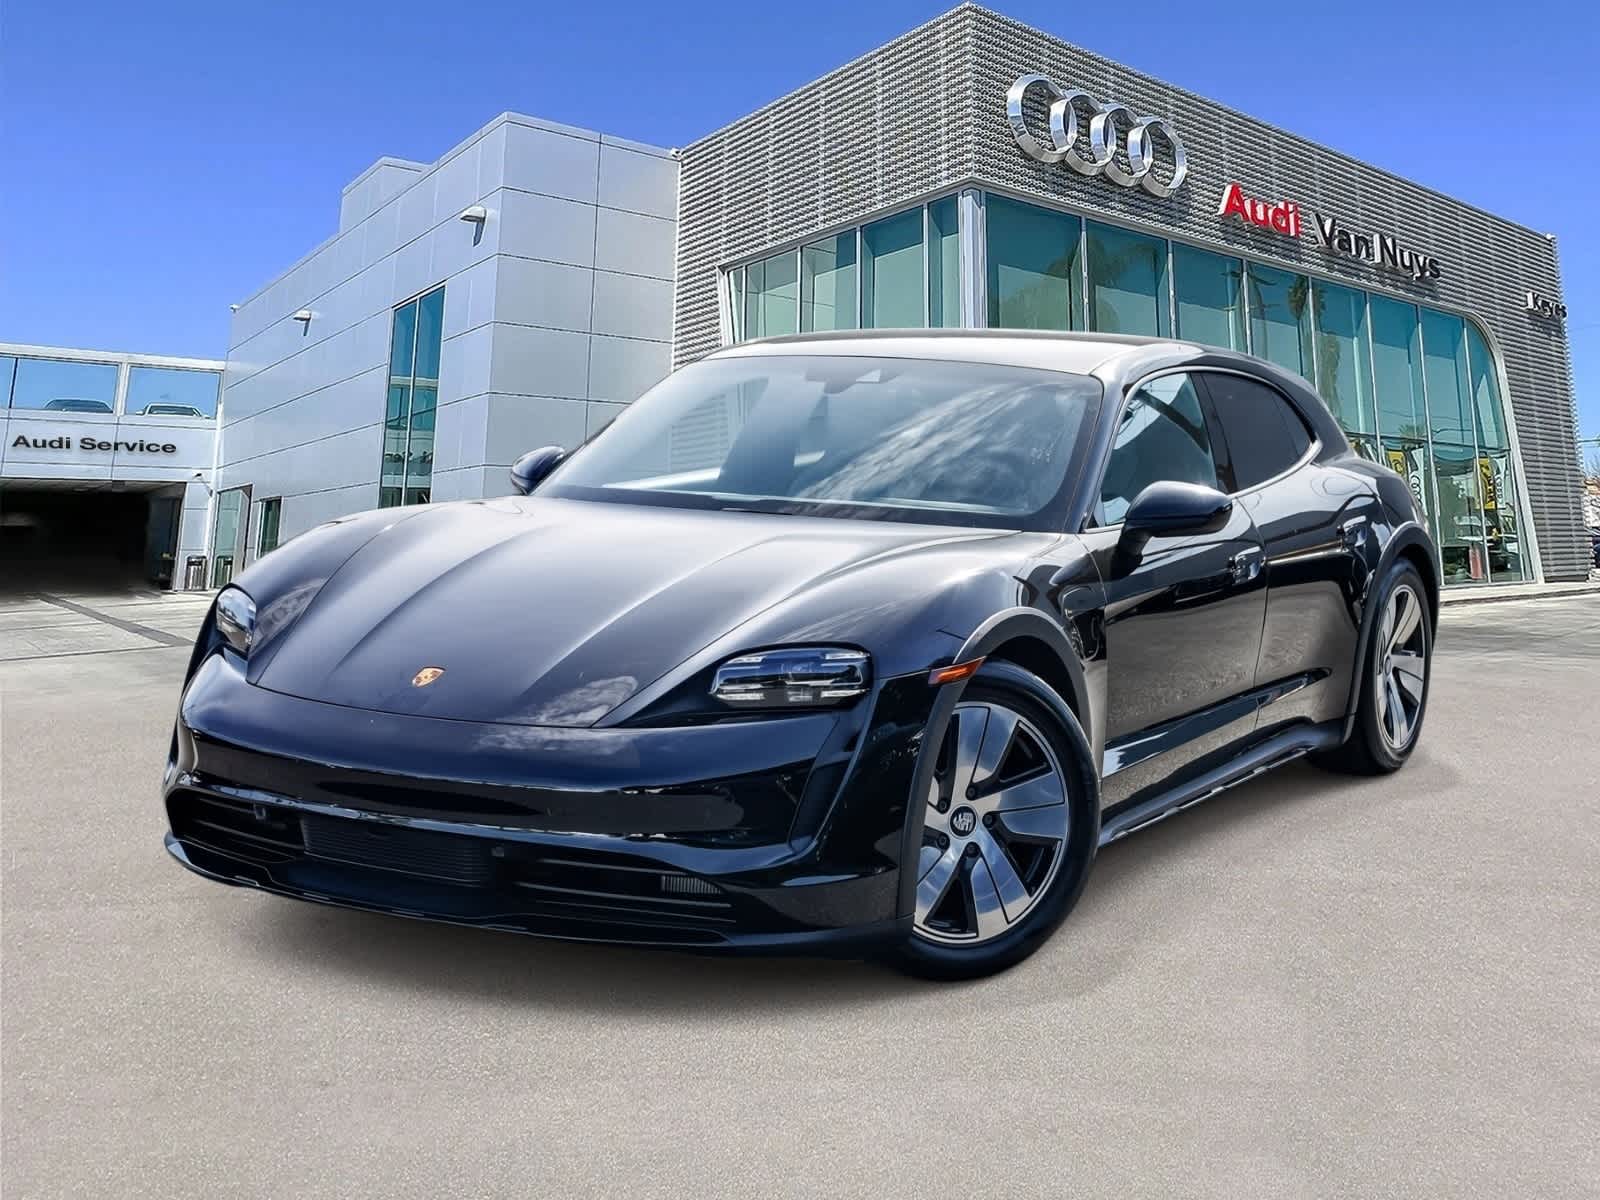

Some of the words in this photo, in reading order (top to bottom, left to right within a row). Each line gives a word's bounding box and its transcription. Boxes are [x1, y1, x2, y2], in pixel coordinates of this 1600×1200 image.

[1218, 181, 1302, 239] Audi
[1311, 211, 1372, 261] Van
[1373, 233, 1441, 280] Nuys
[12, 435, 71, 450] Audi
[79, 437, 177, 454] Service
